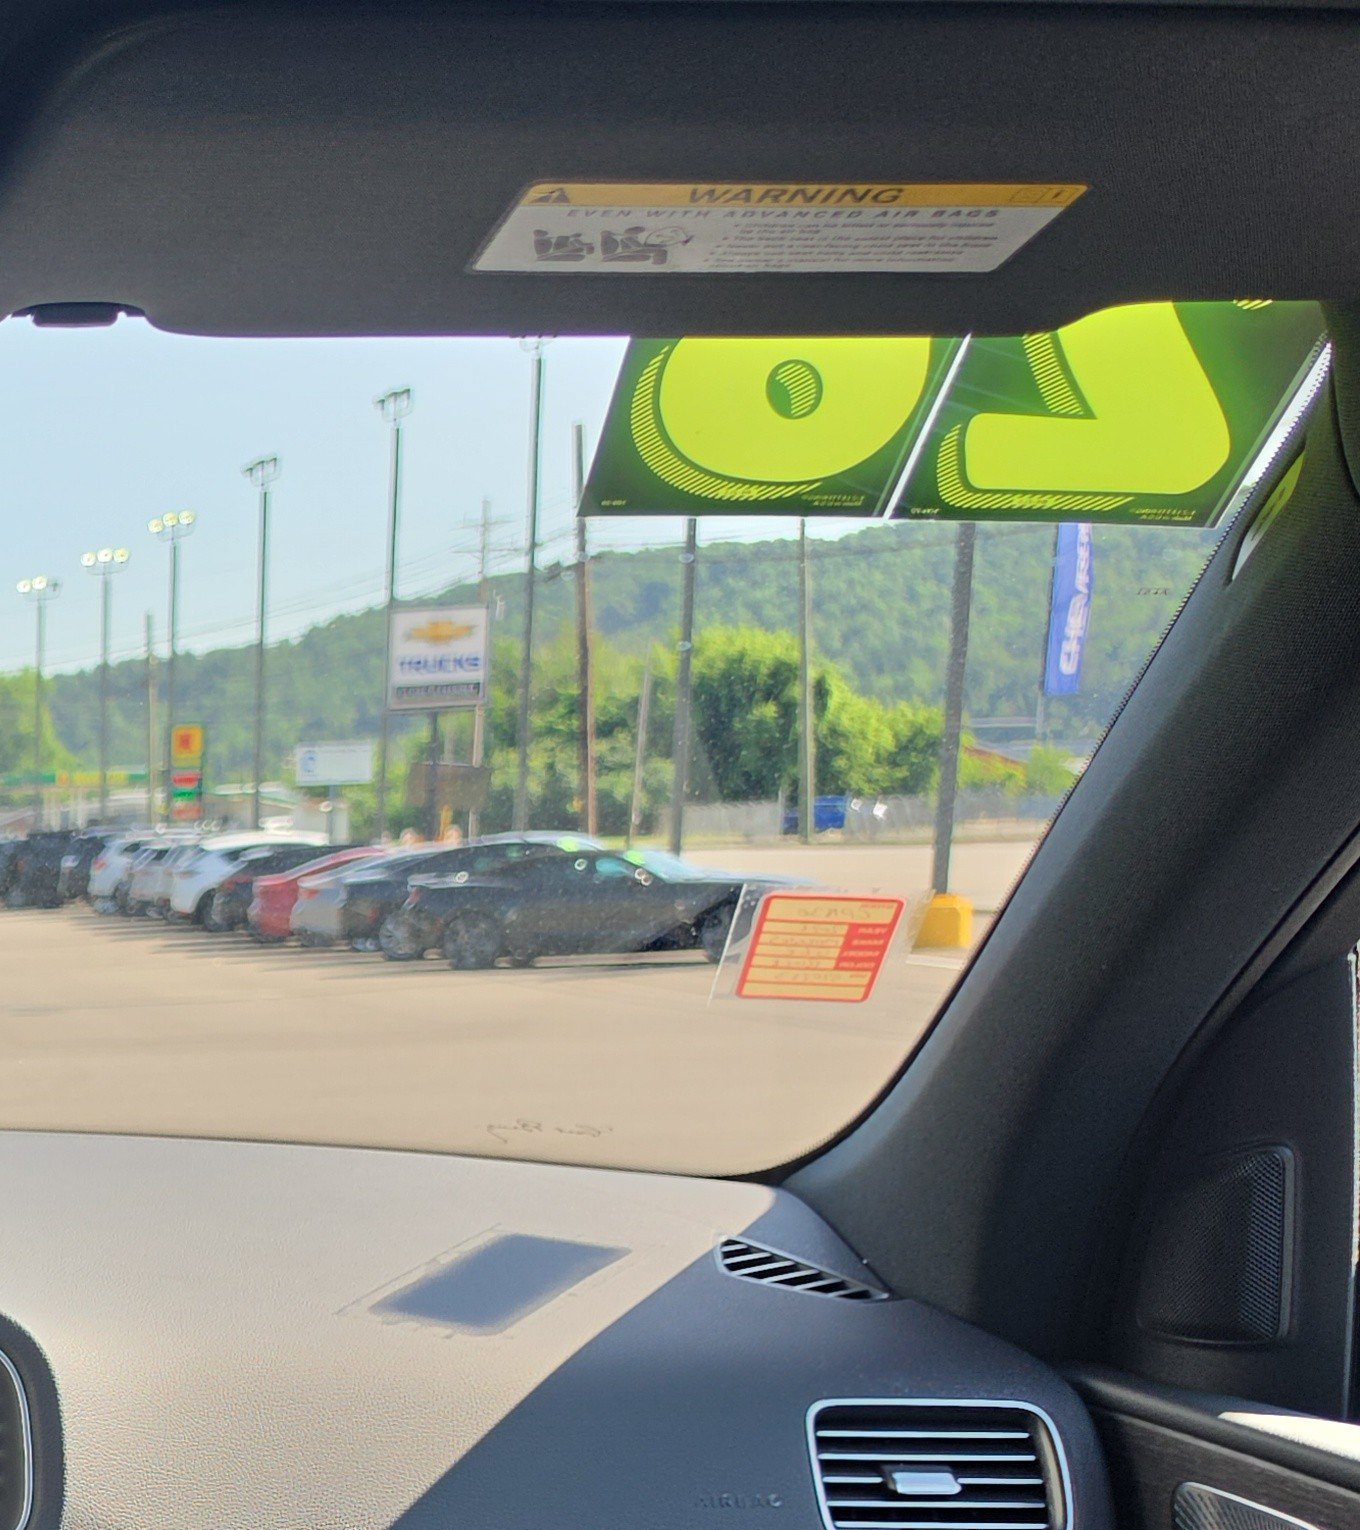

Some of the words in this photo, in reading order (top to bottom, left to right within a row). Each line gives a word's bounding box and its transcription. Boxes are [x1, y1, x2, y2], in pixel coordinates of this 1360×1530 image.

[689, 188, 905, 204] WARNING
[567, 208, 631, 218] EVEN
[638, 208, 711, 218] WITH
[724, 210, 862, 219] ADVANCED
[876, 210, 918, 219] AIR
[932, 209, 1000, 218] BAGS
